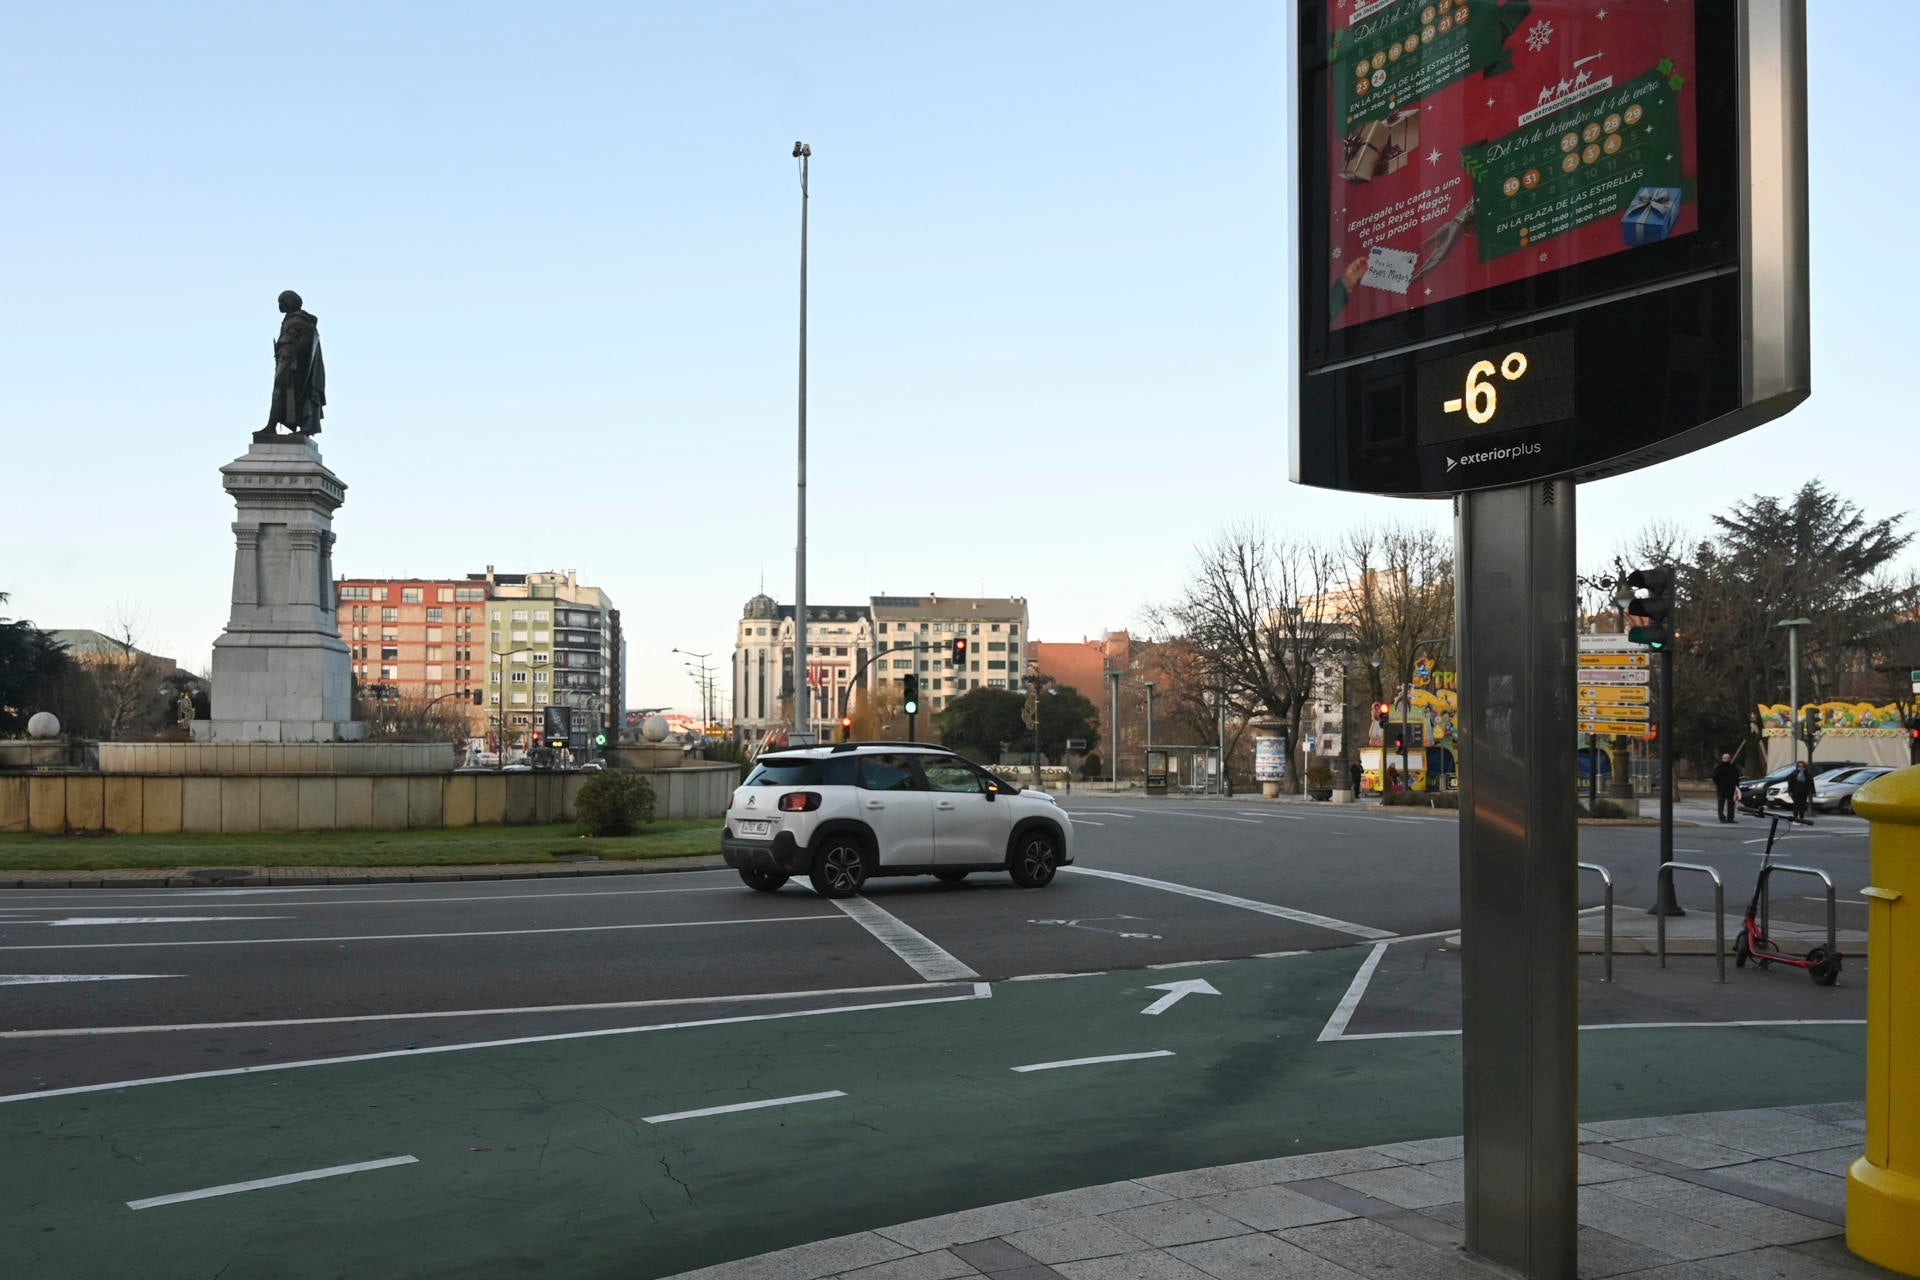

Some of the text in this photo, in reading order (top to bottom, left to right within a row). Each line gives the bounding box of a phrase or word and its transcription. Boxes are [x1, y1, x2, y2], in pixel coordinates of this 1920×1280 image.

[1354, 20, 1377, 42] Del
[1350, 43, 1470, 112] EN LA PLAZA DE LAS ESTRELLAS
[1373, 72, 1384, 84] 24
[1486, 142, 1511, 163] Del
[1514, 134, 1529, 151] 26
[1530, 128, 1544, 144] de
[1545, 110, 1592, 138] diciembre
[1593, 100, 1606, 118] al
[1617, 89, 1631, 107] de
[1632, 80, 1659, 99] enero
[1522, 114, 1532, 122] Un
[1534, 90, 1586, 118] extraordinario
[1563, 136, 1577, 150] 26
[1585, 127, 1598, 140] 27
[1605, 118, 1618, 132] 28
[1626, 109, 1641, 122] 29
[1347, 205, 1393, 233] ¡Entrégale
[1394, 199, 1405, 211] tu
[1407, 190, 1432, 205] carta
[1442, 176, 1461, 190] uno
[1496, 168, 1644, 234] EN LA PLAZA DE LAS ESTRELLAS
[1504, 180, 1518, 193] 30
[1359, 193, 1452, 239] de los Reyes Magos,
[1362, 203, 1450, 249] en su propio salón!
[1460, 442, 1542, 466] exteriorplus
[1432, 671, 1457, 689] TR
